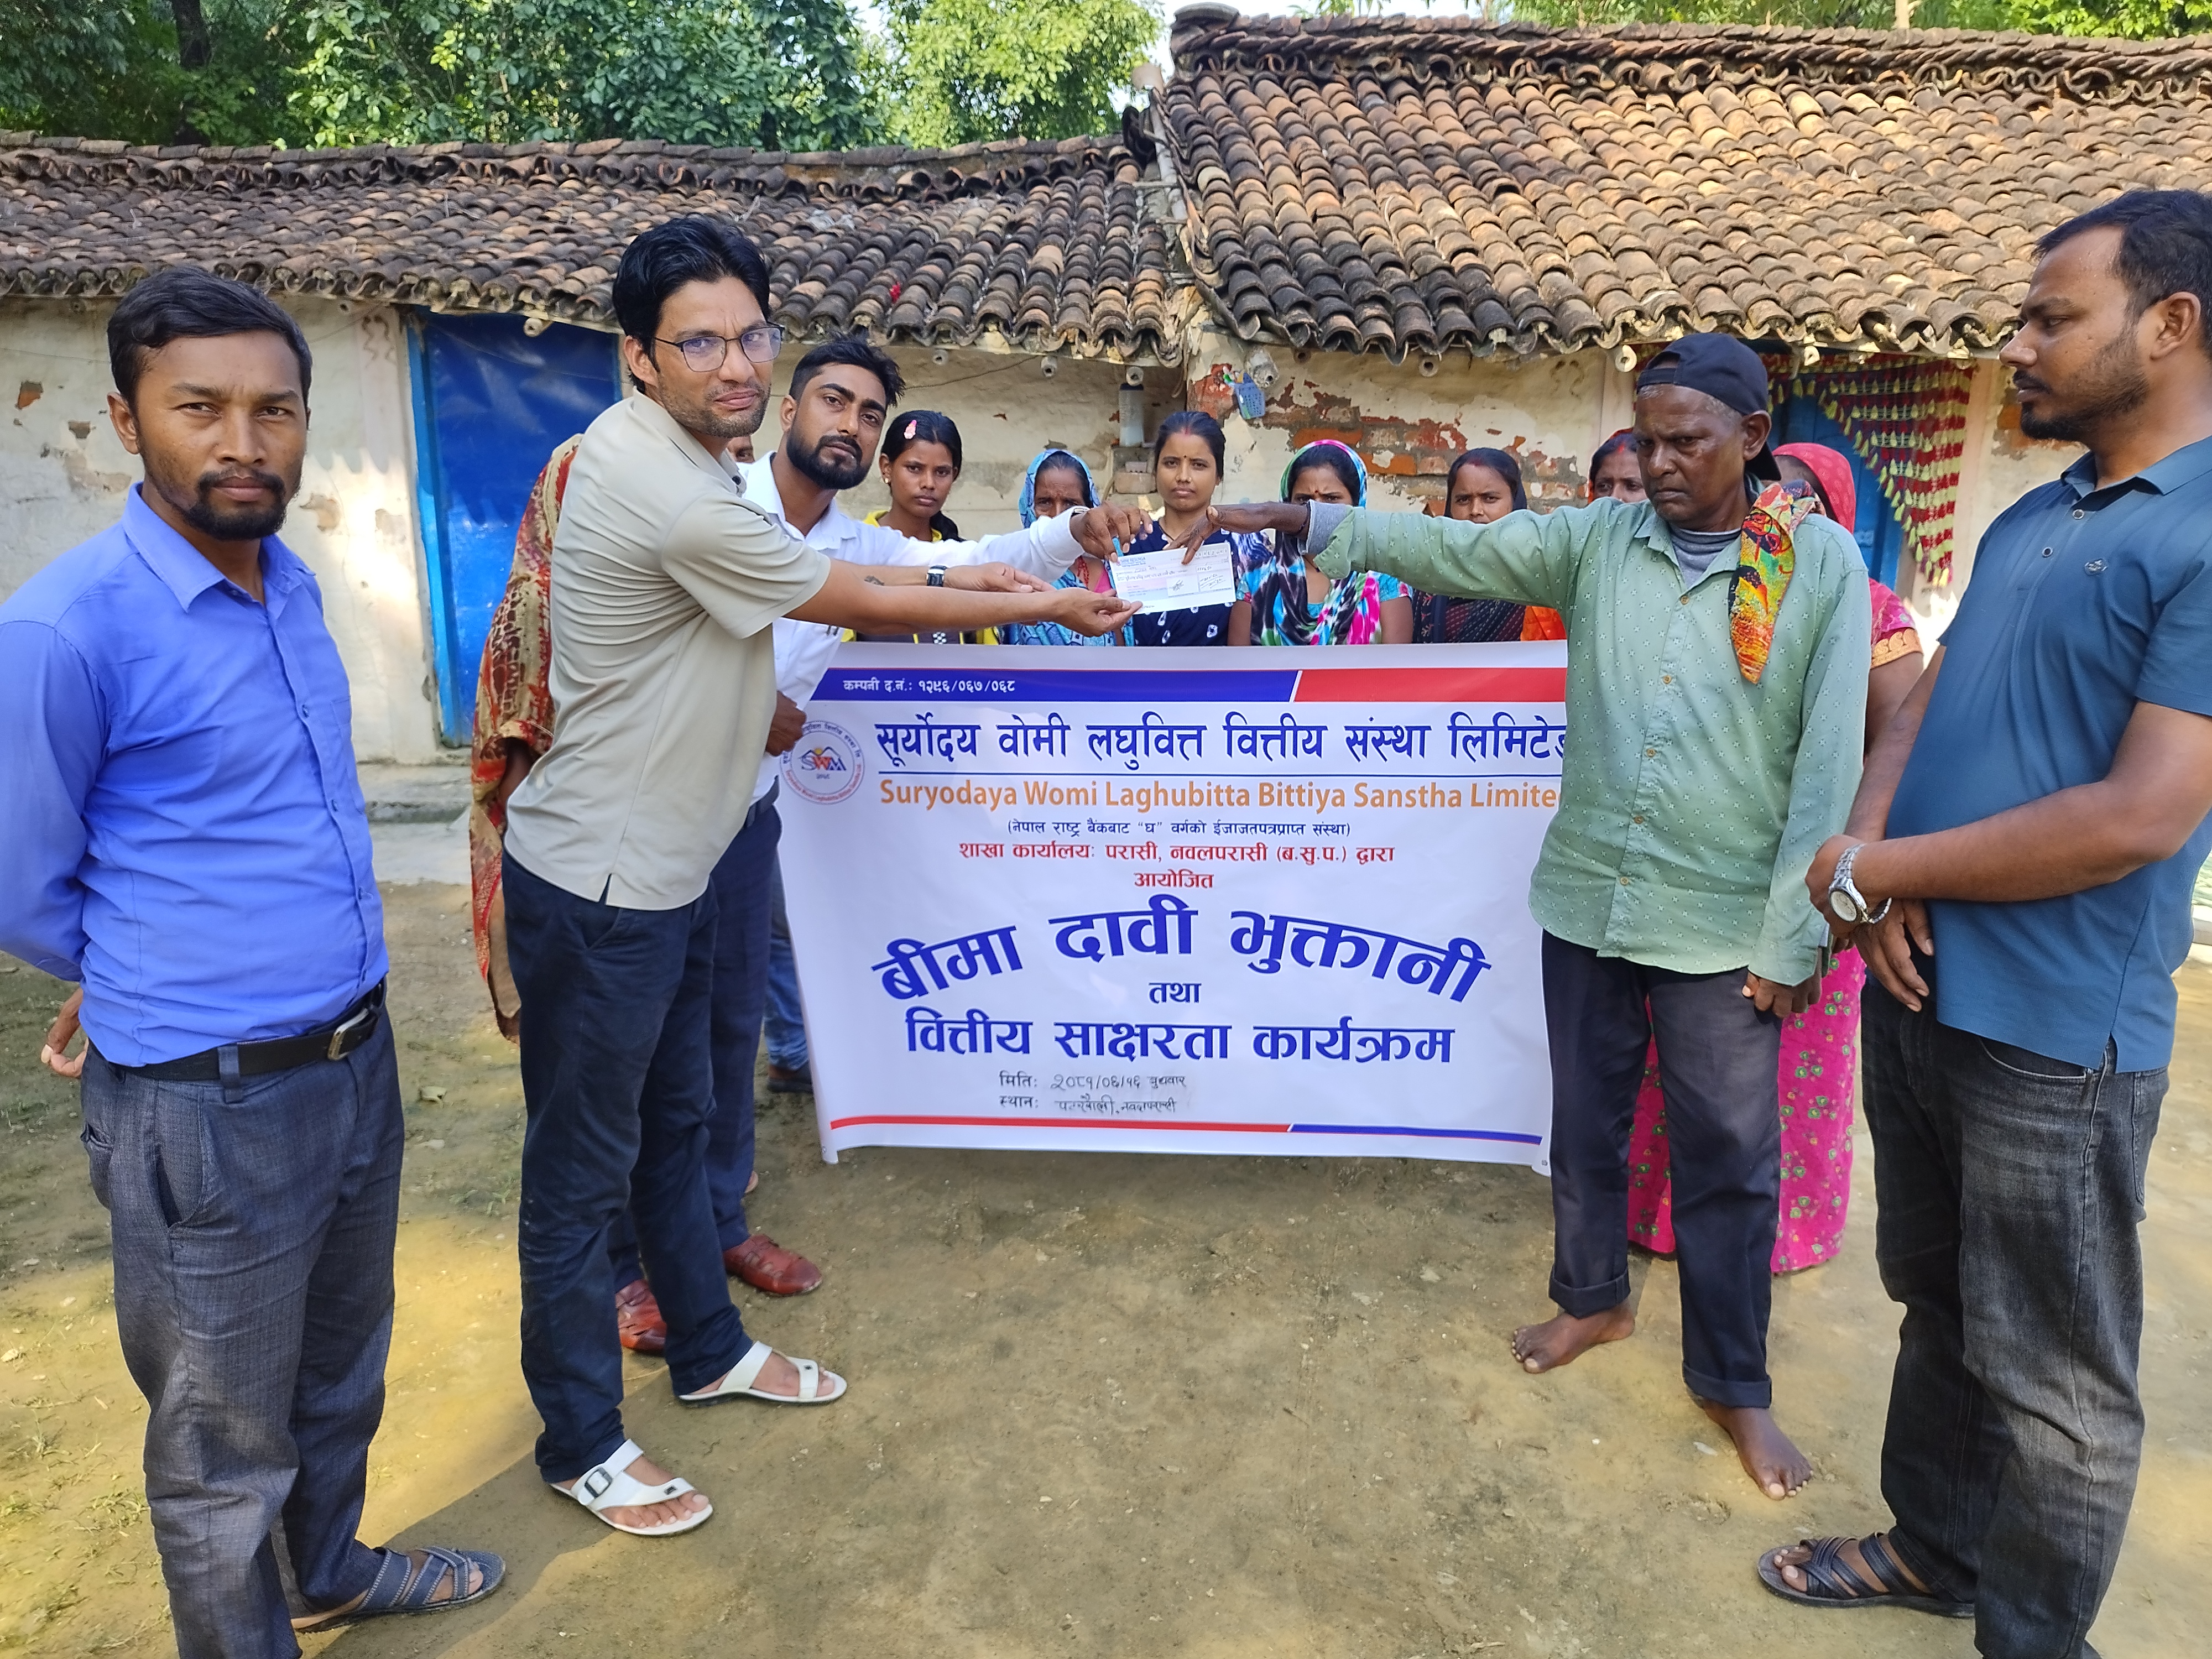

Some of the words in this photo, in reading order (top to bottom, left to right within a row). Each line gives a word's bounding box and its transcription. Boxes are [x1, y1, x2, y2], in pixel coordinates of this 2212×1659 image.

[843, 676, 880, 691] कम्पनी
[874, 712, 982, 768] सूर्योदय
[995, 712, 1072, 757] वोमी
[1085, 711, 1208, 771] लघुवित्त
[1222, 711, 1329, 762] वित्तीय
[1344, 715, 1432, 763] संस्था
[880, 779, 1016, 812] Suryodaya
[1023, 780, 1097, 806] Womi
[1105, 780, 1250, 813] Laghubitta
[1259, 781, 1345, 815] Bittiya
[1354, 782, 1462, 808] Sanstha
[1470, 781, 1561, 808] Limite
[1008, 818, 1046, 833] (नेपाल
[1052, 822, 1082, 837] राष्ट्र
[1170, 819, 1207, 833] वर्गको
[1312, 821, 1350, 837] संस्था)
[959, 843, 1004, 858] शाखा
[1105, 841, 1162, 862] परासी,
[1170, 842, 1269, 862] नवलपरासी
[1356, 847, 1395, 865] द्वारा
[1134, 869, 1214, 889] आयोजित
[870, 925, 1023, 1000] बीमा
[1047, 894, 1199, 963] दावी
[1230, 911, 1492, 1003] भुक्तानी
[1149, 982, 1202, 1004] तथा
[905, 1006, 1034, 1055] वित्तीय
[1053, 1022, 1233, 1062] साक्षरता
[1253, 1016, 1455, 1063] कार्यक्रम
